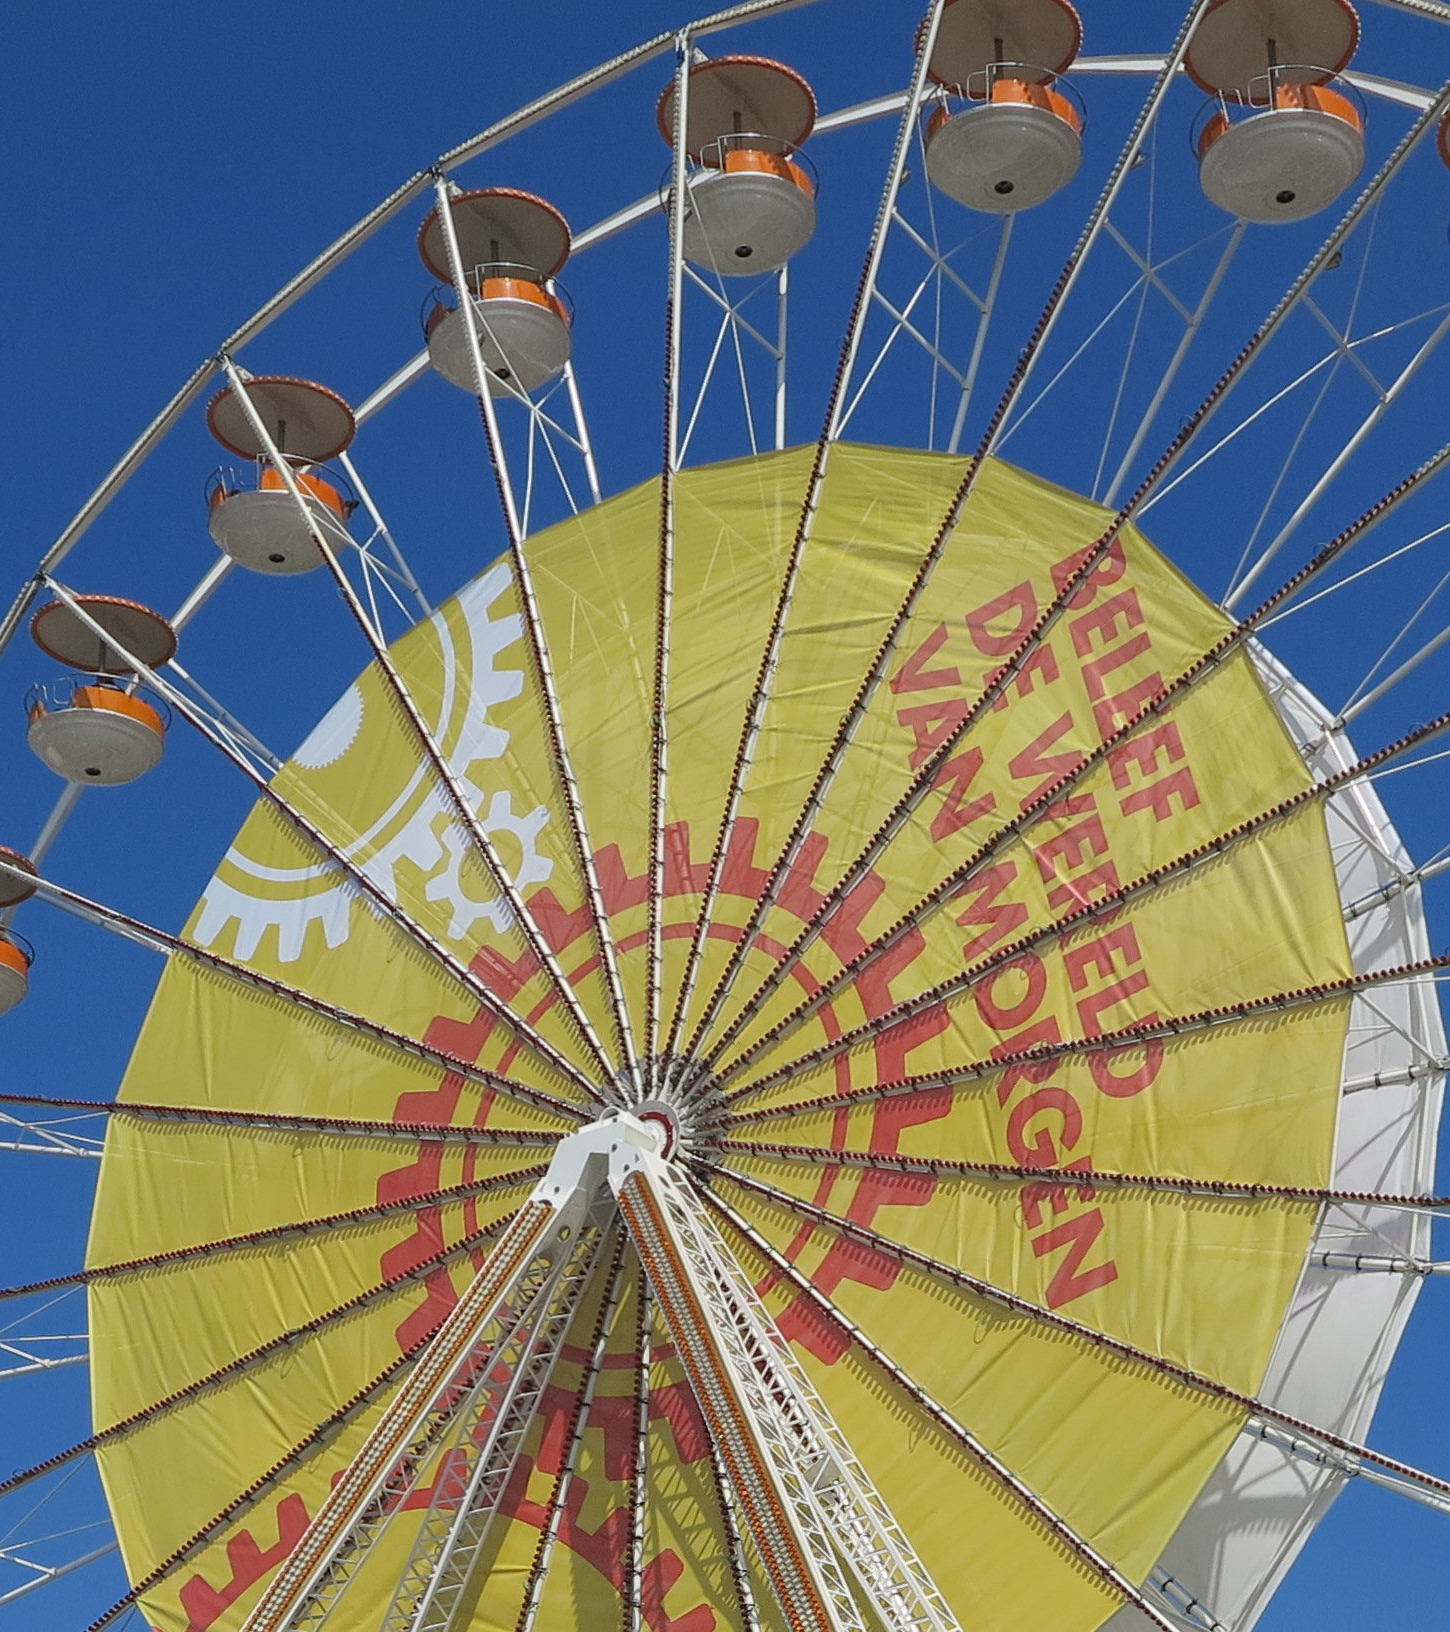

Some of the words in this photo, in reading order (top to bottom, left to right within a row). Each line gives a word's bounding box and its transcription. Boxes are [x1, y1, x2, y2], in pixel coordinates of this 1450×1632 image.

[965, 580, 1059, 716] DE
[1050, 541, 1202, 822] BELEEF
[890, 623, 997, 842] VAN
[951, 861, 1118, 1310] MORGEN
[1007, 710, 1165, 1099] WERELD
